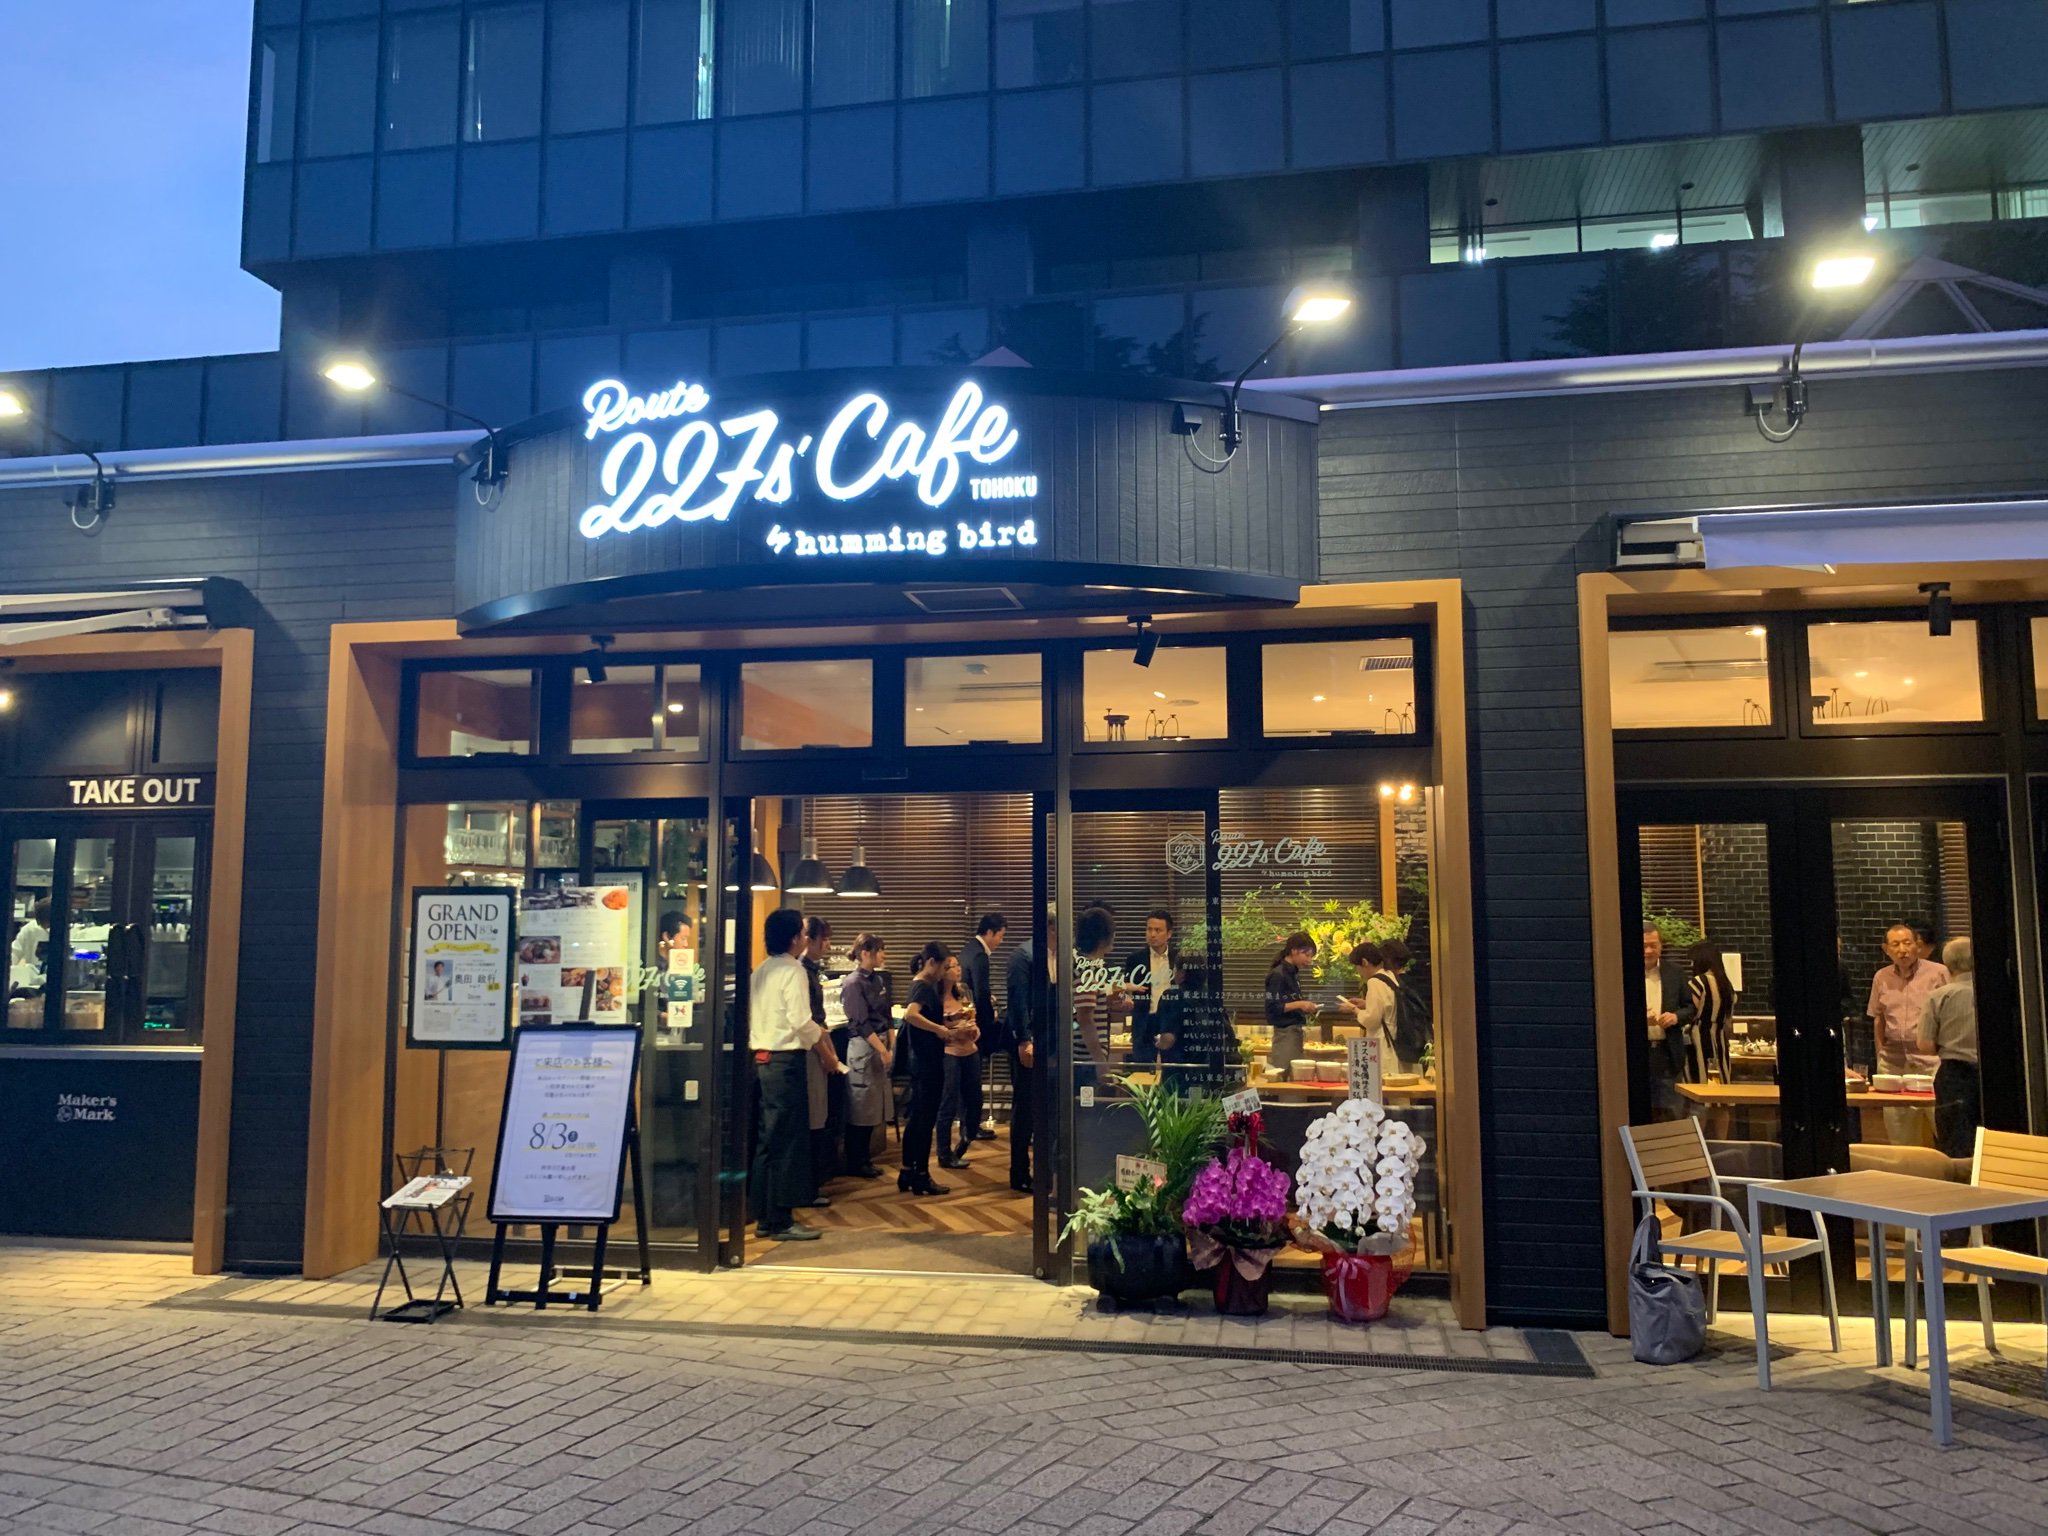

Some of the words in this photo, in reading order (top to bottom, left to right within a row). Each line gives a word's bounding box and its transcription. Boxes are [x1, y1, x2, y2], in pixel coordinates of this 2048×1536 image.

[582, 378, 711, 440] Route
[815, 380, 1020, 507] Cafe
[969, 474, 1039, 501] TOHOKU
[794, 525, 948, 558] humming
[956, 518, 1039, 551] bird
[68, 778, 136, 805] TAKE
[141, 777, 201, 803] OUT
[1274, 835, 1328, 867] Cafe
[427, 903, 499, 922] GRAND
[427, 922, 479, 941] OPEN
[1075, 955, 1106, 970] Route
[57, 1093, 118, 1107] Maker's
[73, 1107, 116, 1121] Mark
[529, 1122, 568, 1150] 8/3
